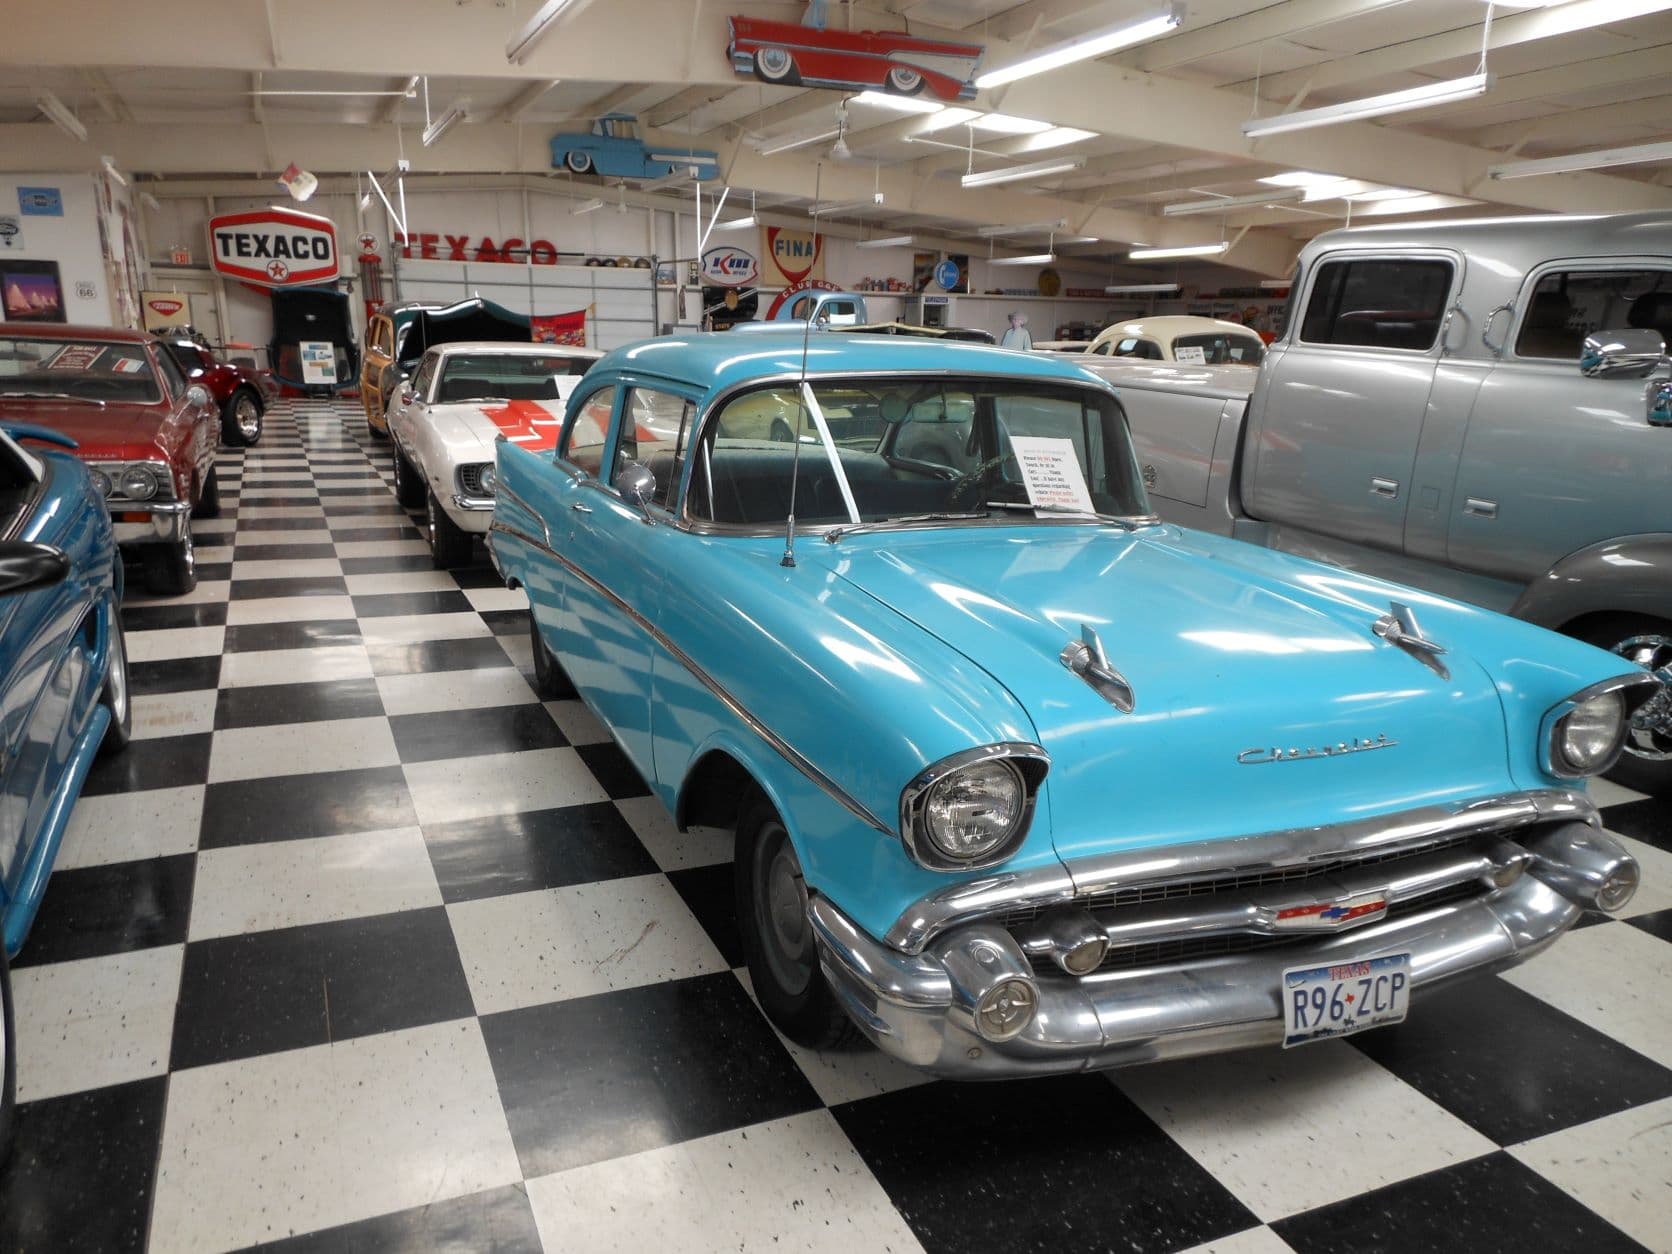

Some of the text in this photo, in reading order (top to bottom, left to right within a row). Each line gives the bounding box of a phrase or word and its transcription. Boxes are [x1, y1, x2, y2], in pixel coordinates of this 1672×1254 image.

[216, 232, 330, 260] TEXACO
[393, 231, 559, 266] TEXACO
[775, 239, 813, 257] FINA
[1328, 960, 1372, 981] TEXAS
[1293, 971, 1406, 1030] R96 ZCP
